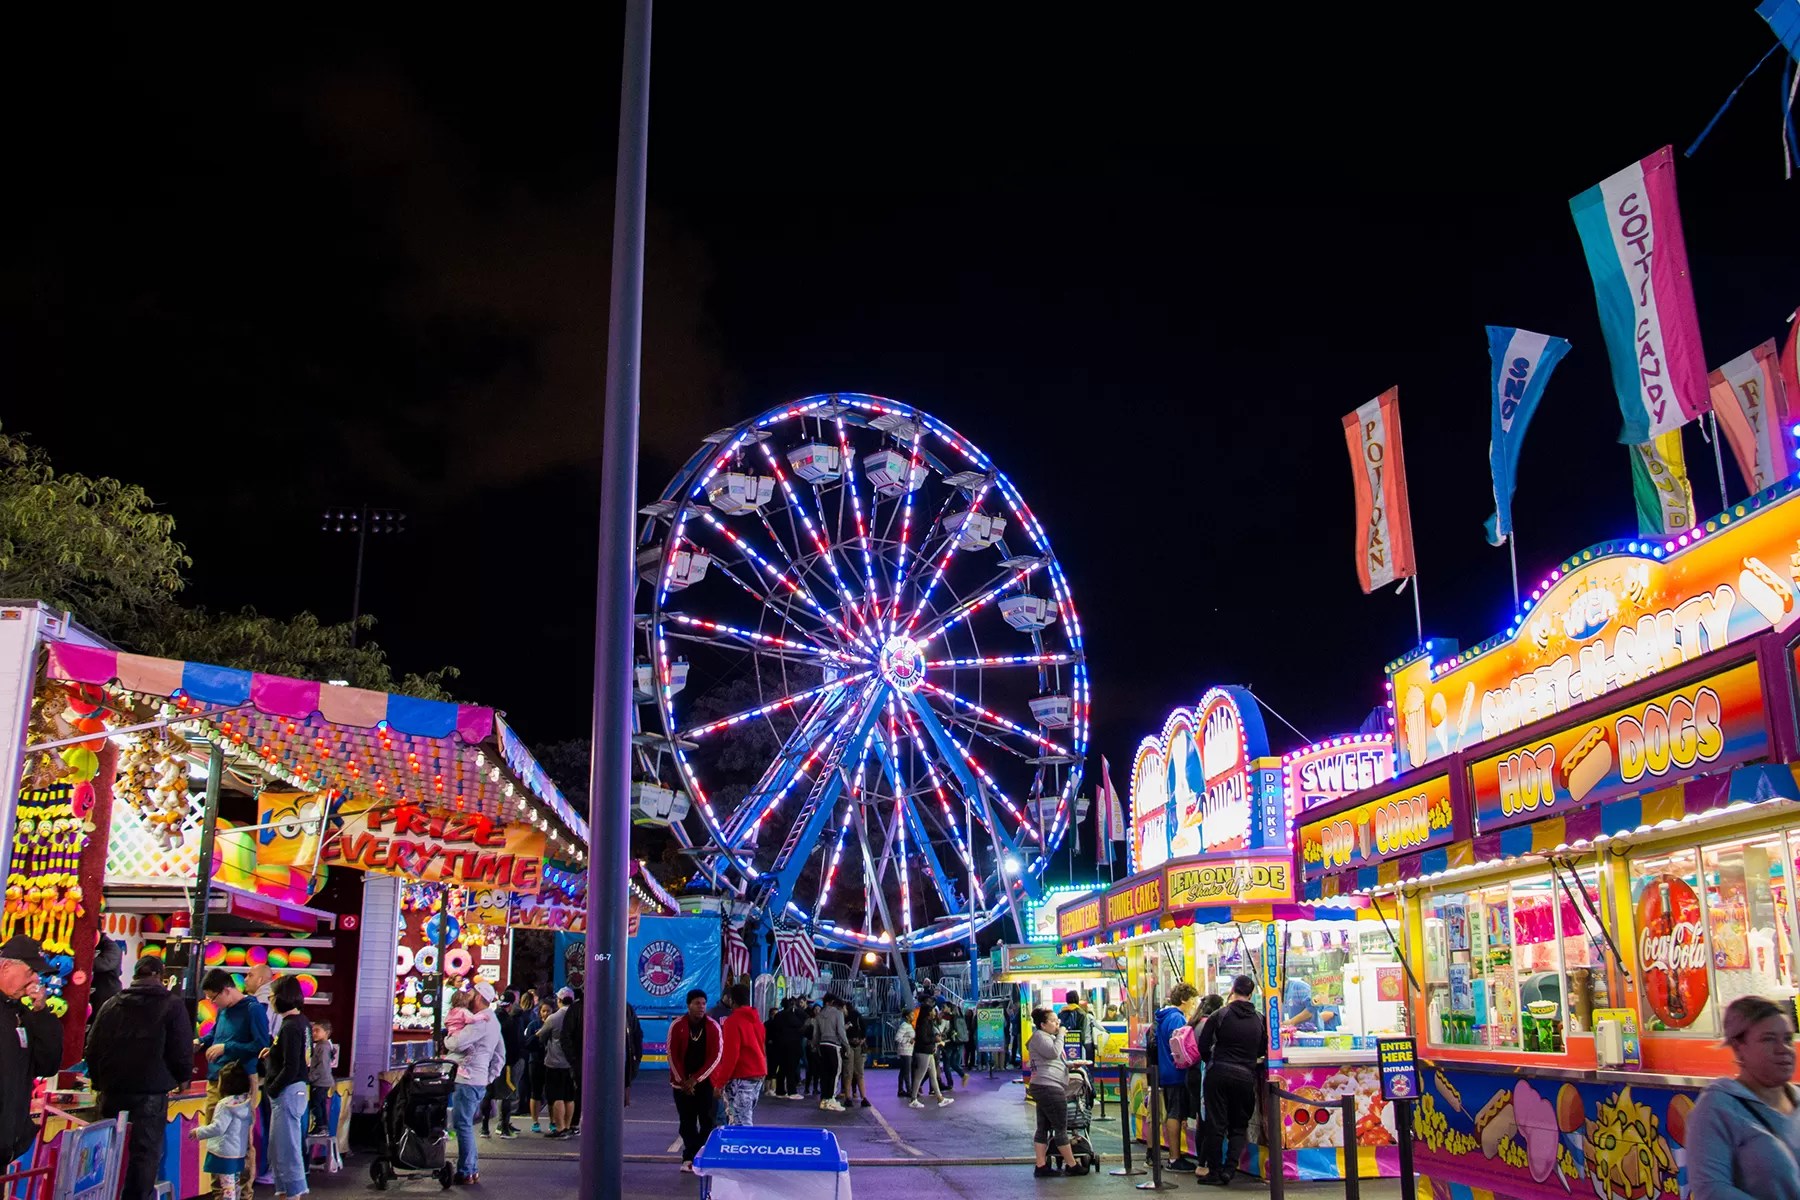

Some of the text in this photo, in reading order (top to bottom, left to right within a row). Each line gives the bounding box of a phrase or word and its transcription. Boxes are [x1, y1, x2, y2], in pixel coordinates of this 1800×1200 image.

[1637, 318, 1666, 424] CANDY
[1300, 749, 1385, 792] SWEET
[1497, 685, 1725, 818] HOT DOGS
[1264, 772, 1277, 838] DRINKS
[366, 806, 508, 849] PRIZE
[1320, 792, 1430, 870] POP CORN
[317, 828, 542, 891] EVERYTIME
[1107, 878, 1161, 923] FUNNEL CAKES
[1170, 866, 1286, 899] LEMONADE
[1187, 878, 1253, 902] Shake Ups
[1061, 901, 1100, 938] ELEPHANT EARS
[594, 953, 612, 961] 06-7
[1639, 920, 1707, 972] Coca-Cola
[1266, 923, 1280, 1051] FUNNEL CAKES
[1380, 1041, 1413, 1051] ENTER
[1382, 1051, 1414, 1062] HERE
[367, 1074, 375, 1088] 2
[1383, 1065, 1415, 1073] ENTRADA
[719, 1144, 822, 1156] RECYCLABLES
